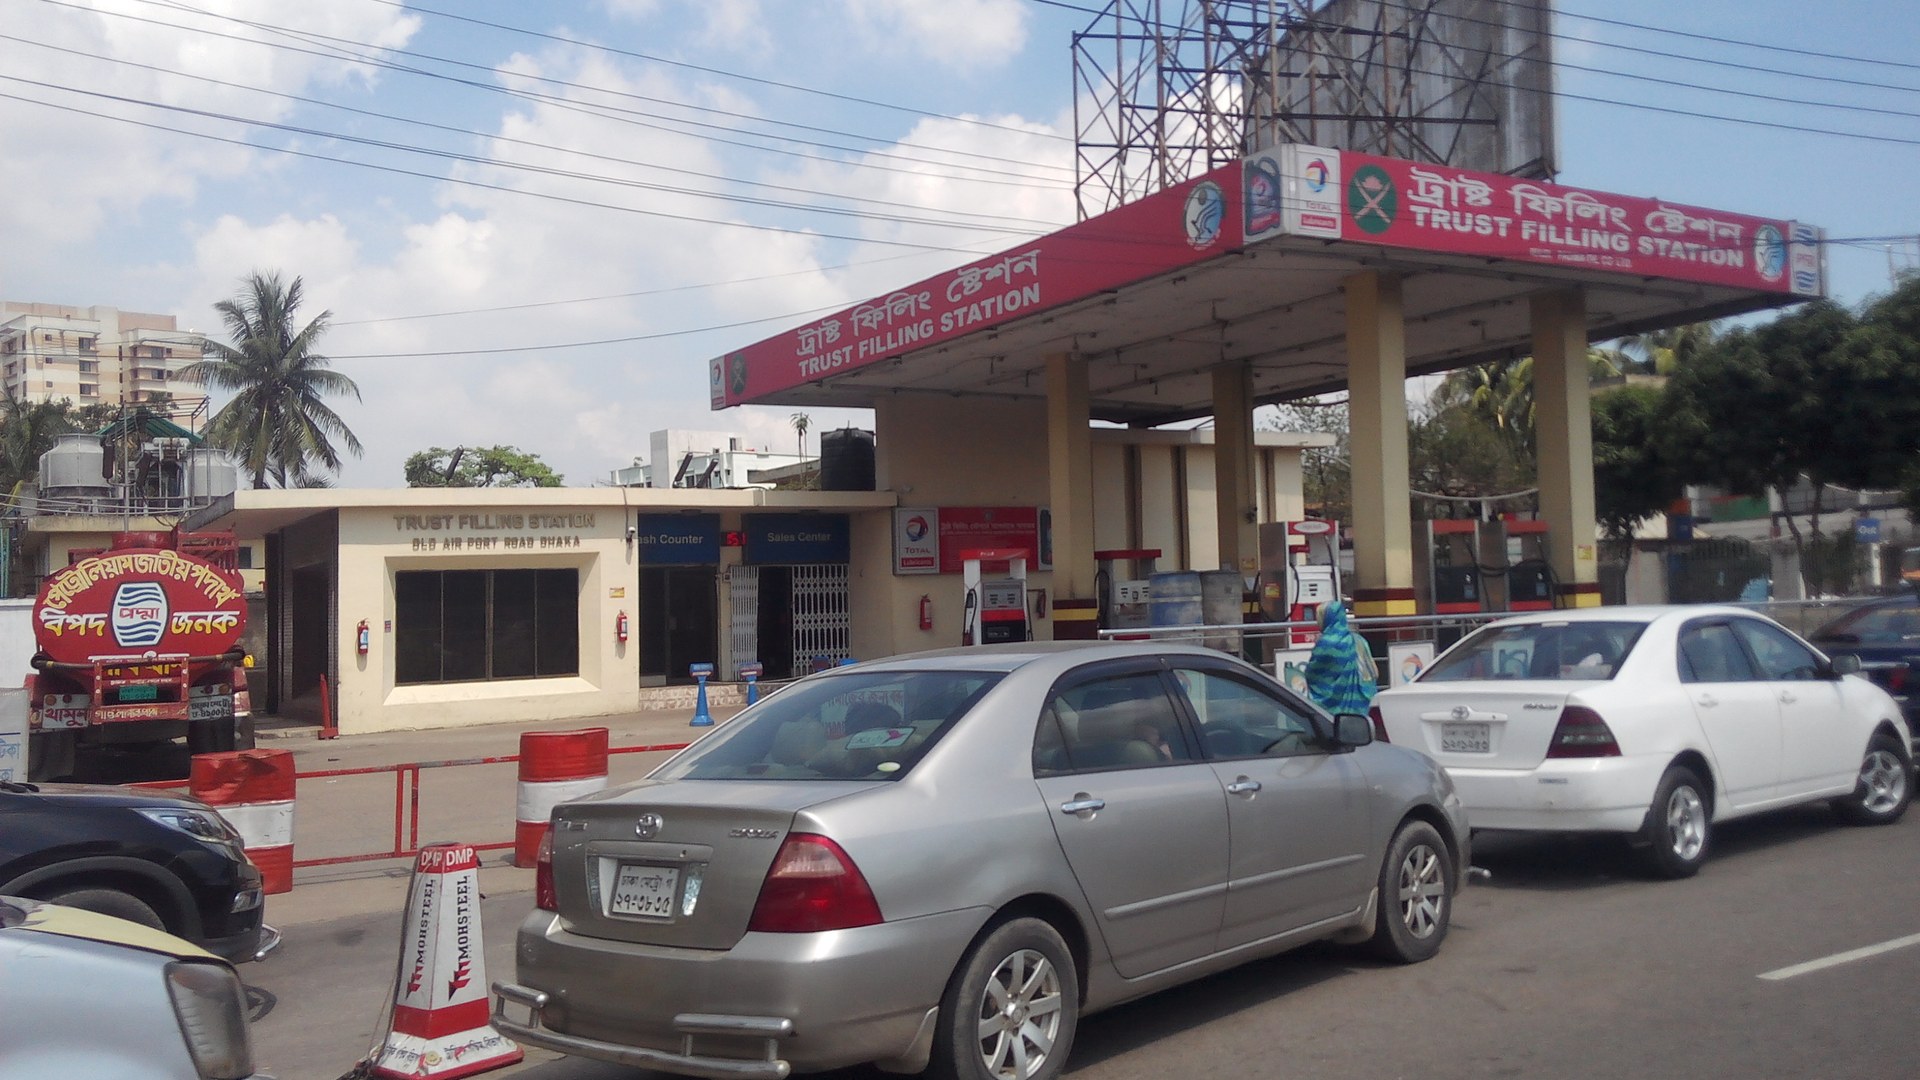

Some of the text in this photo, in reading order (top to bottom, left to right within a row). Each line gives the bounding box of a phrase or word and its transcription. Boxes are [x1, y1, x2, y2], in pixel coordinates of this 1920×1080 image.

[1305, 201, 1333, 212] TOTAL
[1506, 183, 1632, 232] ফিলিং
[1409, 205, 1744, 267] TRUST FILLING STATION
[850, 291, 931, 336] ফিলিং
[799, 282, 1040, 377] TRUST FILLING STATION
[393, 513, 596, 531] TRUST FILLING STATION
[443, 537, 463, 551] AIR
[467, 537, 498, 550] PORT
[504, 536, 534, 549] ROAD
[540, 535, 581, 549] DHAKA
[638, 534, 704, 544] ash Counter
[767, 532, 832, 542] Sales Center
[133, 550, 193, 582] জাতীয়
[40, 607, 240, 636] বিপদ জনক
[118, 606, 160, 621] পদ্মা
[446, 848, 473, 866] DMP
[417, 879, 433, 964] MOHSTEEL
[457, 876, 470, 961] MOHSTEEL
